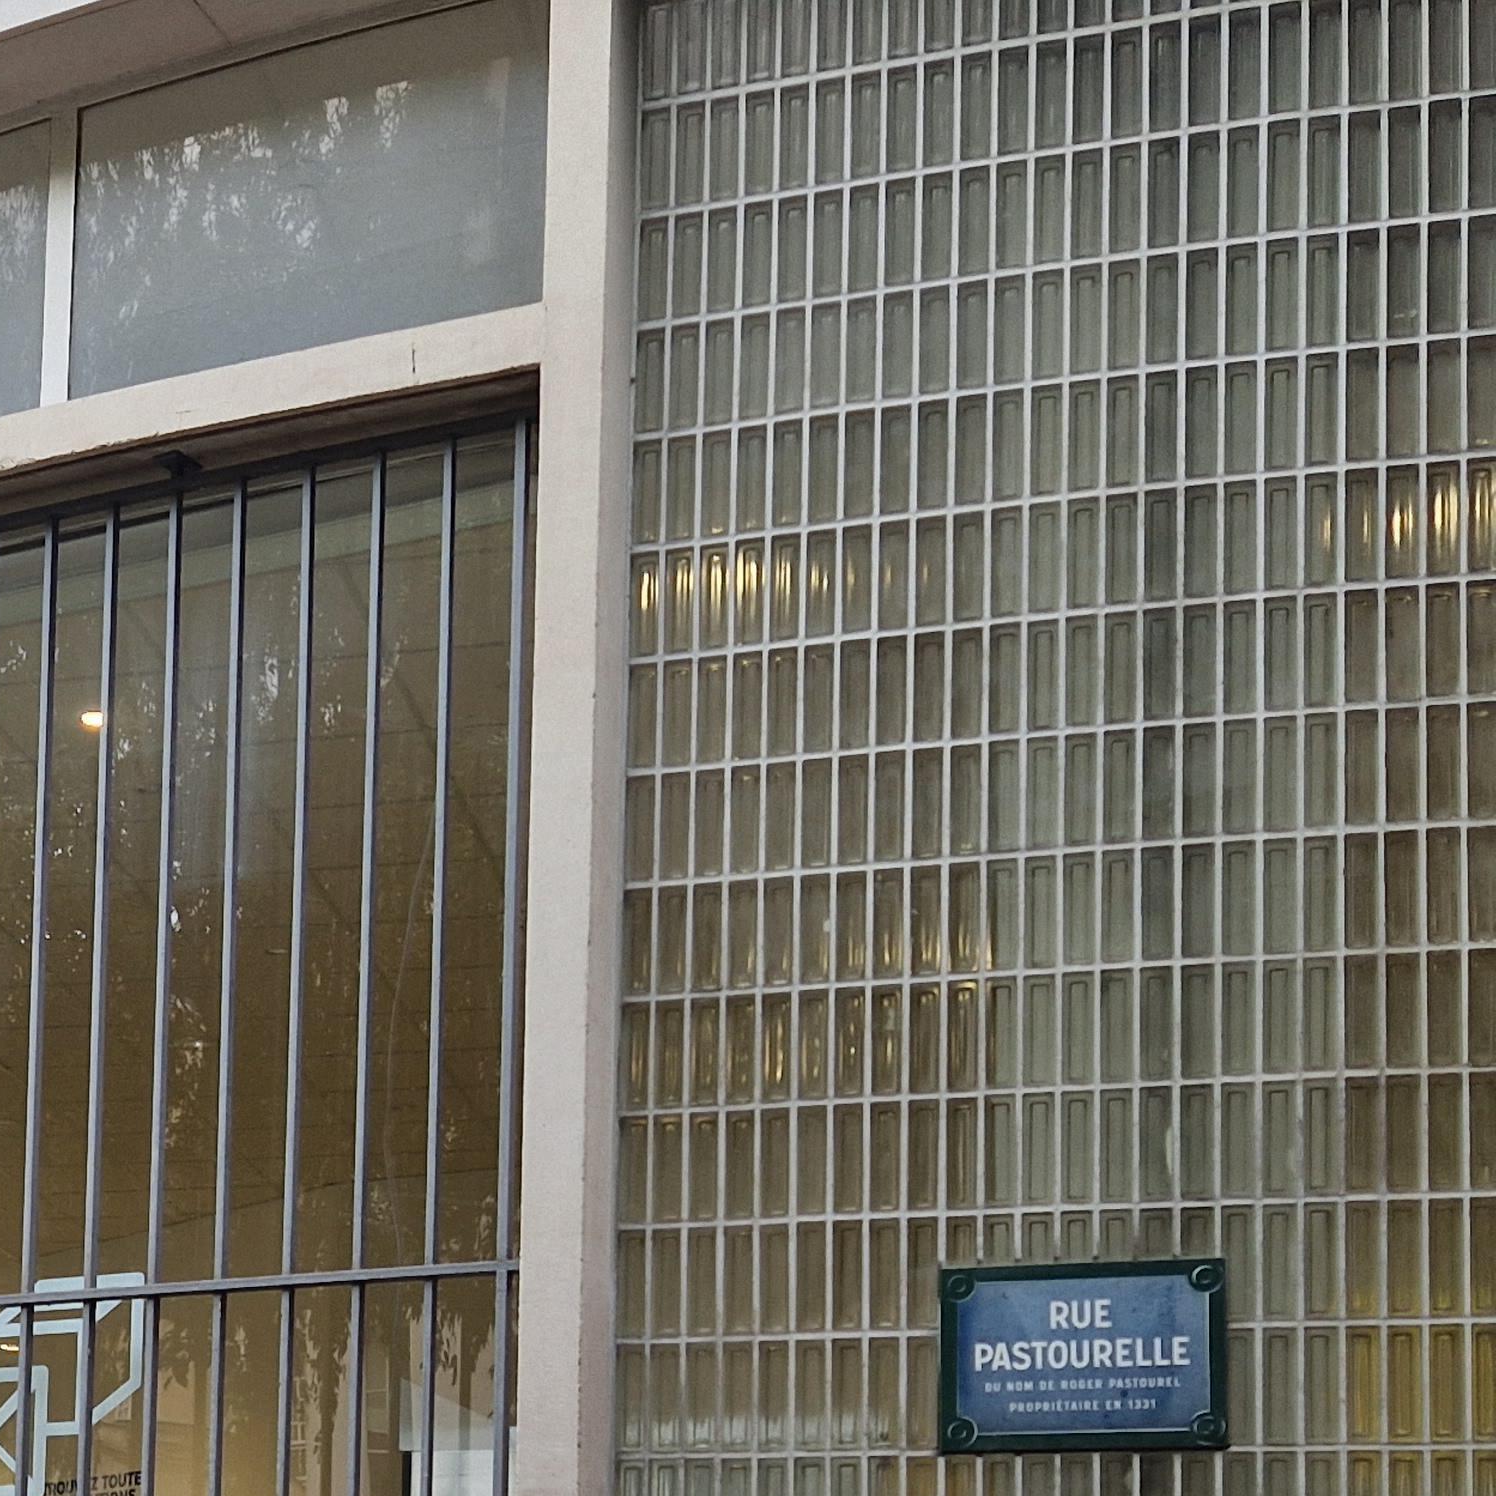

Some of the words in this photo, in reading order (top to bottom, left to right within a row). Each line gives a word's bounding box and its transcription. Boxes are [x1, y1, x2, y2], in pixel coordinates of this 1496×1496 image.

[1049, 1299, 1112, 1329] RUE
[974, 1336, 1191, 1371] PASTOURELLE
[985, 1382, 1001, 1393] DU
[1006, 1381, 1034, 1392] NOM
[1039, 1380, 1054, 1391] DE
[1060, 1379, 1103, 1391] ROGER
[1109, 1377, 1181, 1389] PASTOUREL
[1009, 1400, 1100, 1413] PROPRIÉTAIRE
[1105, 1400, 1122, 1411] EN
[102, 1470, 142, 1490] TOUTE
